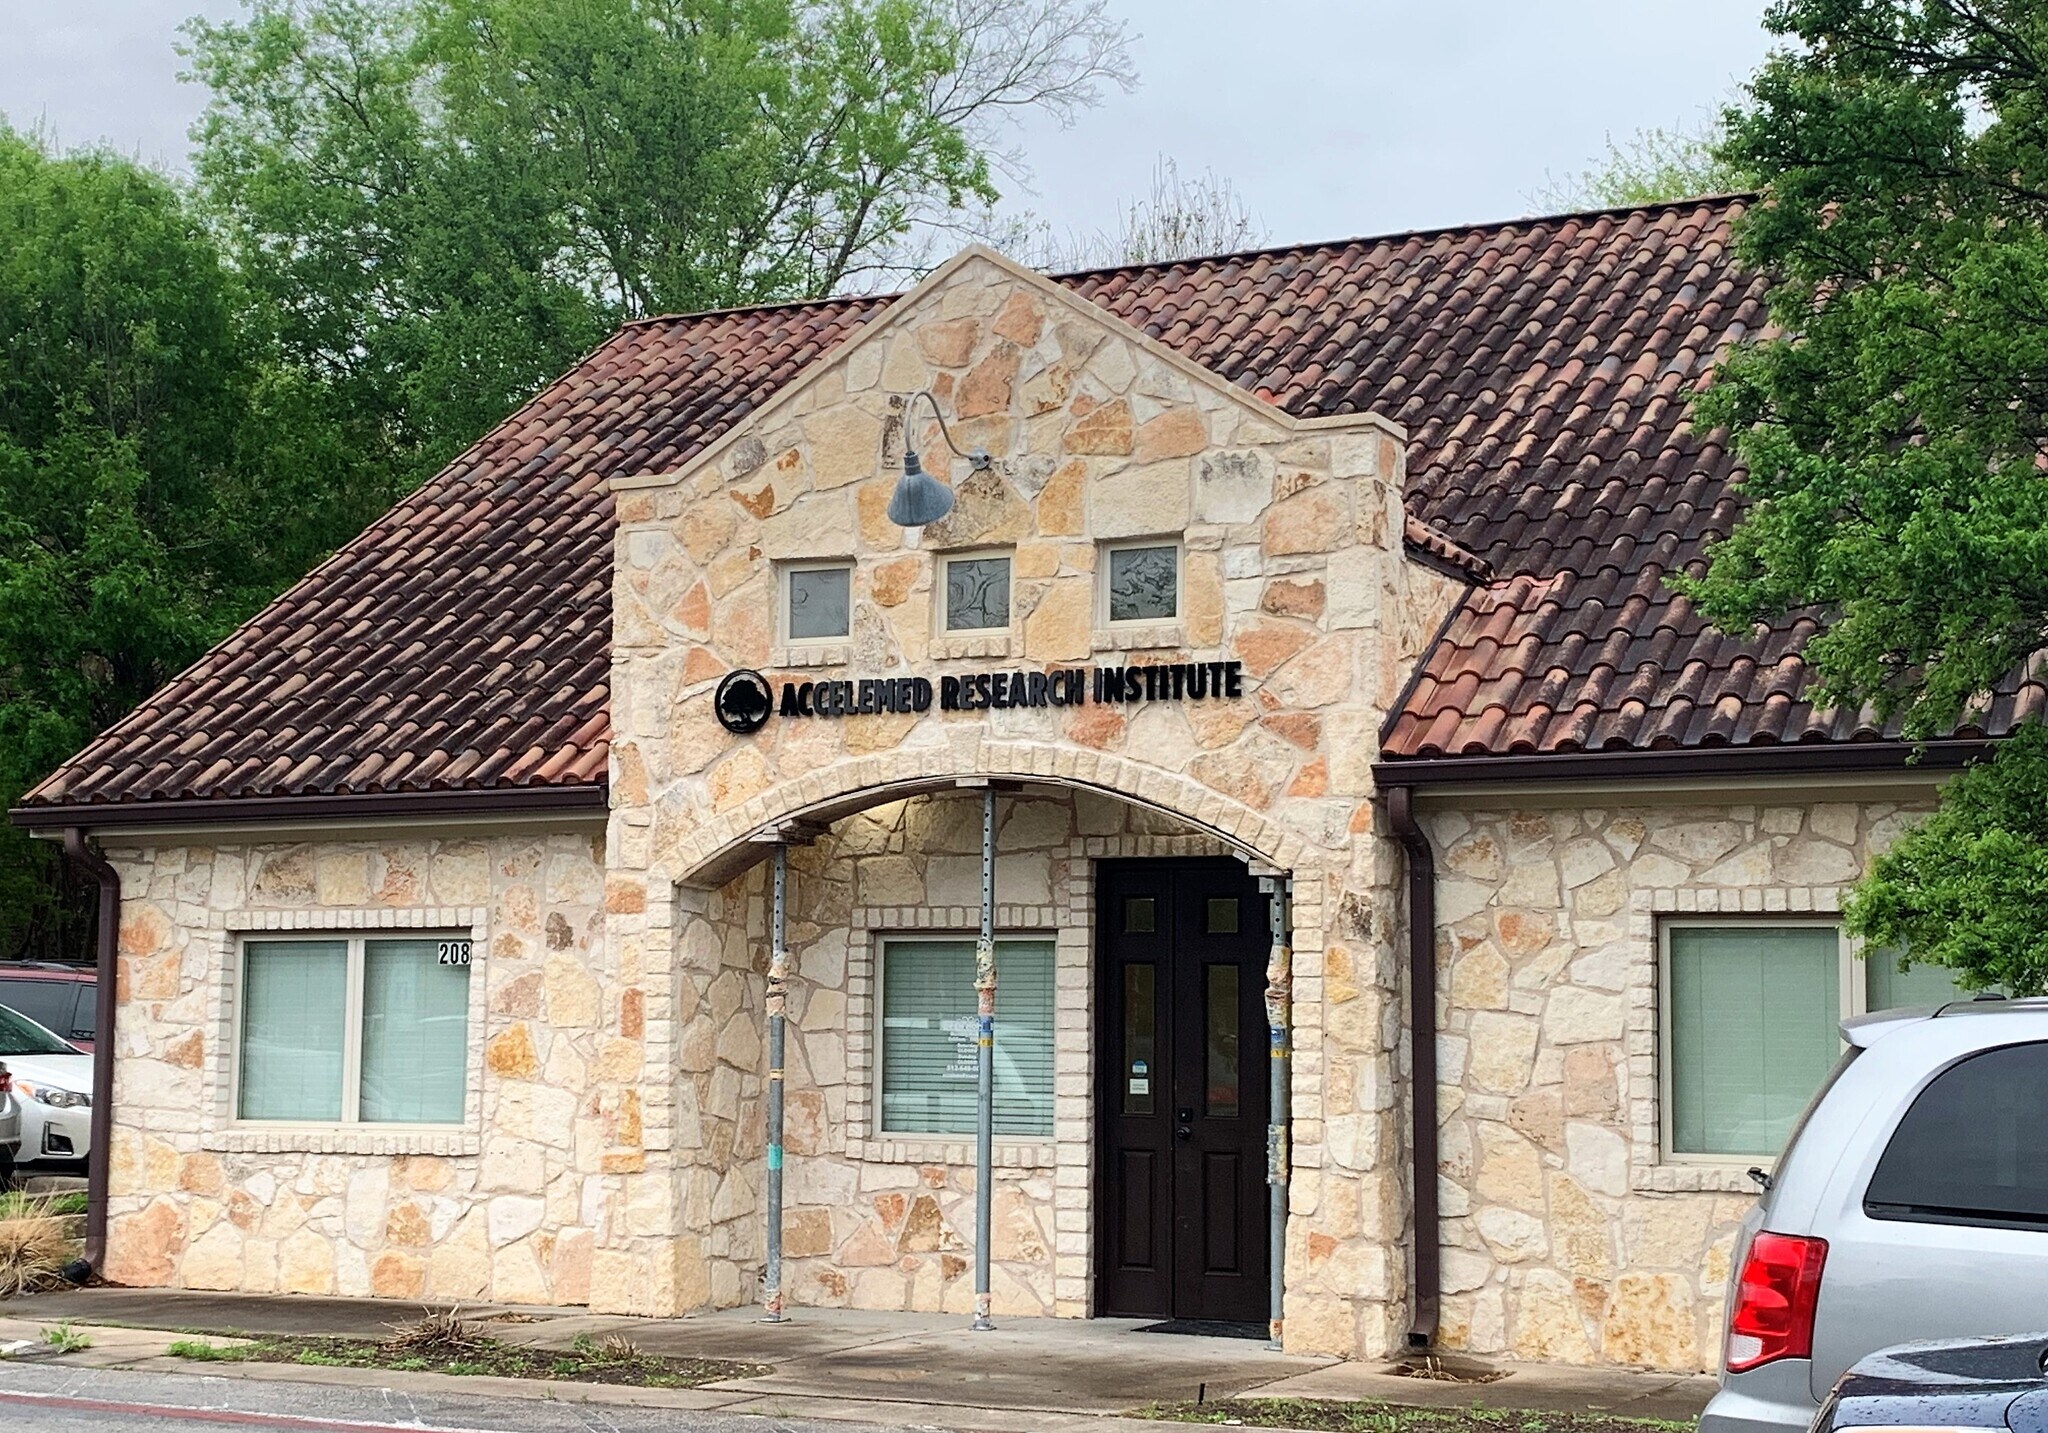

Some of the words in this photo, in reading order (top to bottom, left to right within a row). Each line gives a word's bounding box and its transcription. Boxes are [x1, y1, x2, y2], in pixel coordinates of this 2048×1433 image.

[779, 676, 933, 717] ACCELEMED
[939, 668, 1085, 710] RESEARCH
[1093, 660, 1242, 703] INSTITUTE
[440, 943, 470, 964] 208
